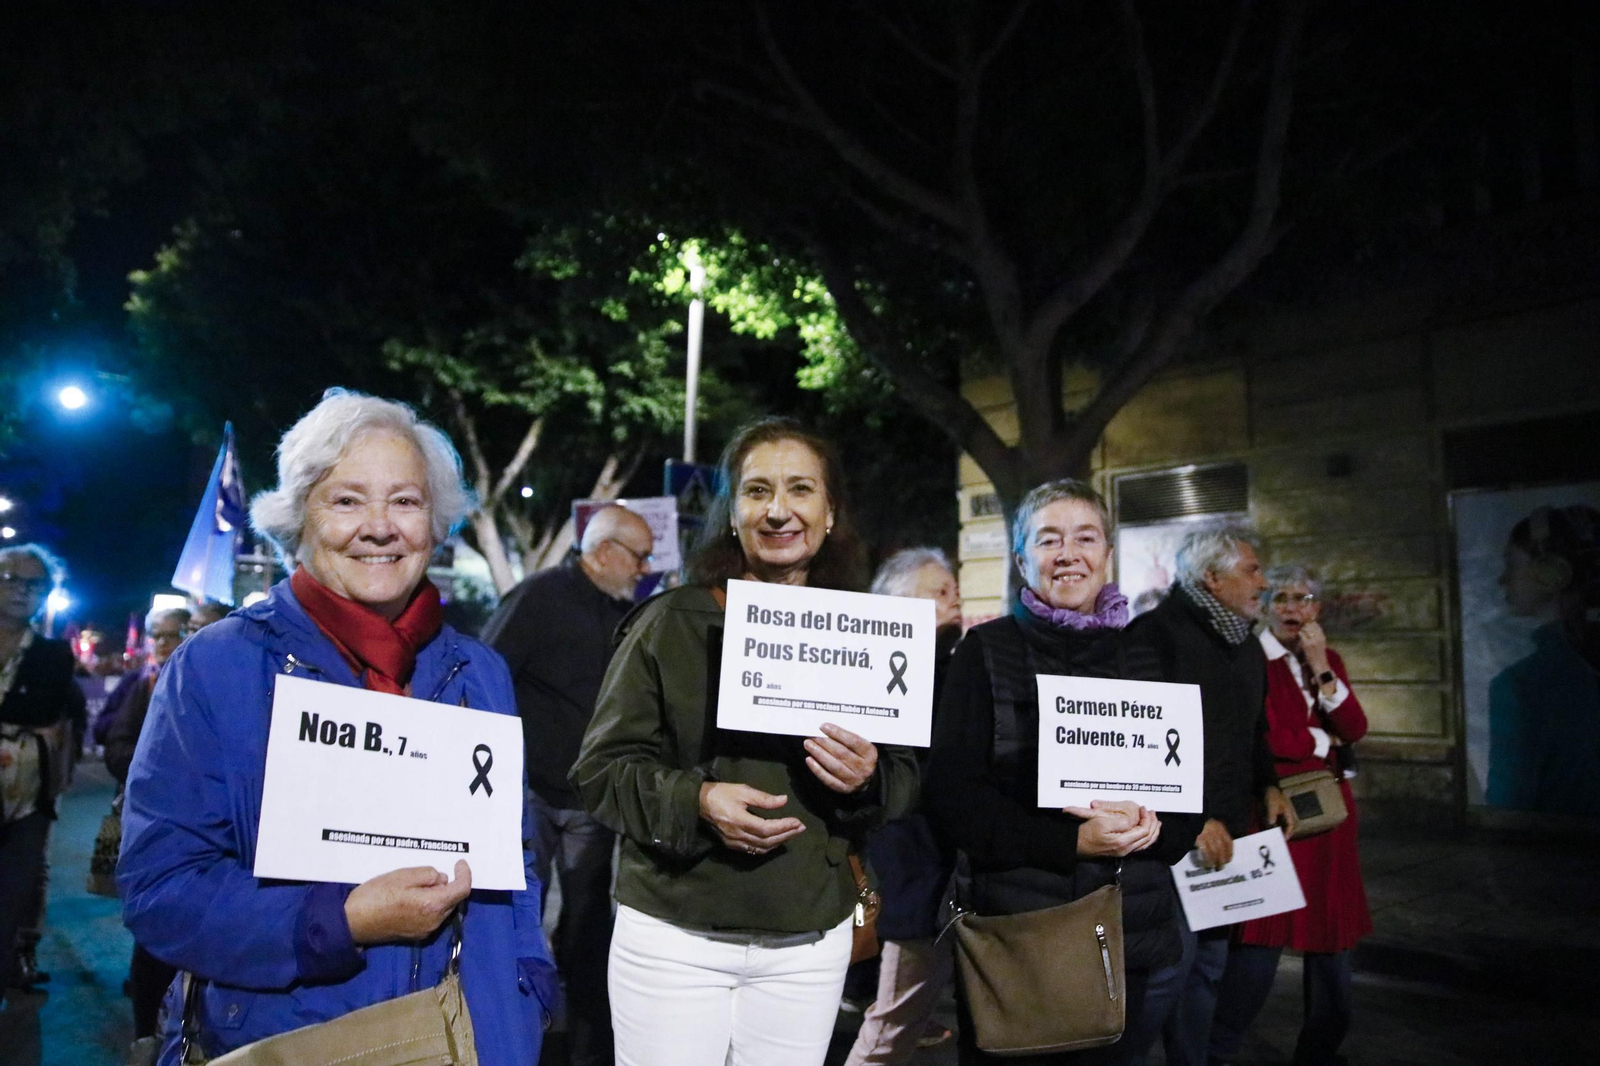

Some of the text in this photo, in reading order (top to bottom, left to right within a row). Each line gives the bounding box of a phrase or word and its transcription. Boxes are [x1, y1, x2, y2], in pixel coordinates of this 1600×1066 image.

[746, 604, 913, 639] Rosa del Carmen
[743, 637, 873, 670] Pous Escrivá,
[741, 670, 763, 688] 66
[1055, 695, 1163, 720] Carmen Pérez
[298, 711, 428, 760] Noa B., 7 años
[1055, 725, 1128, 749] Calvente,
[1131, 734, 1145, 749] 74
[328, 831, 370, 844] asesinada
[370, 835, 385, 846] por
[385, 837, 395, 846] su
[395, 837, 420, 849] padre,
[420, 840, 457, 851] Francisco
